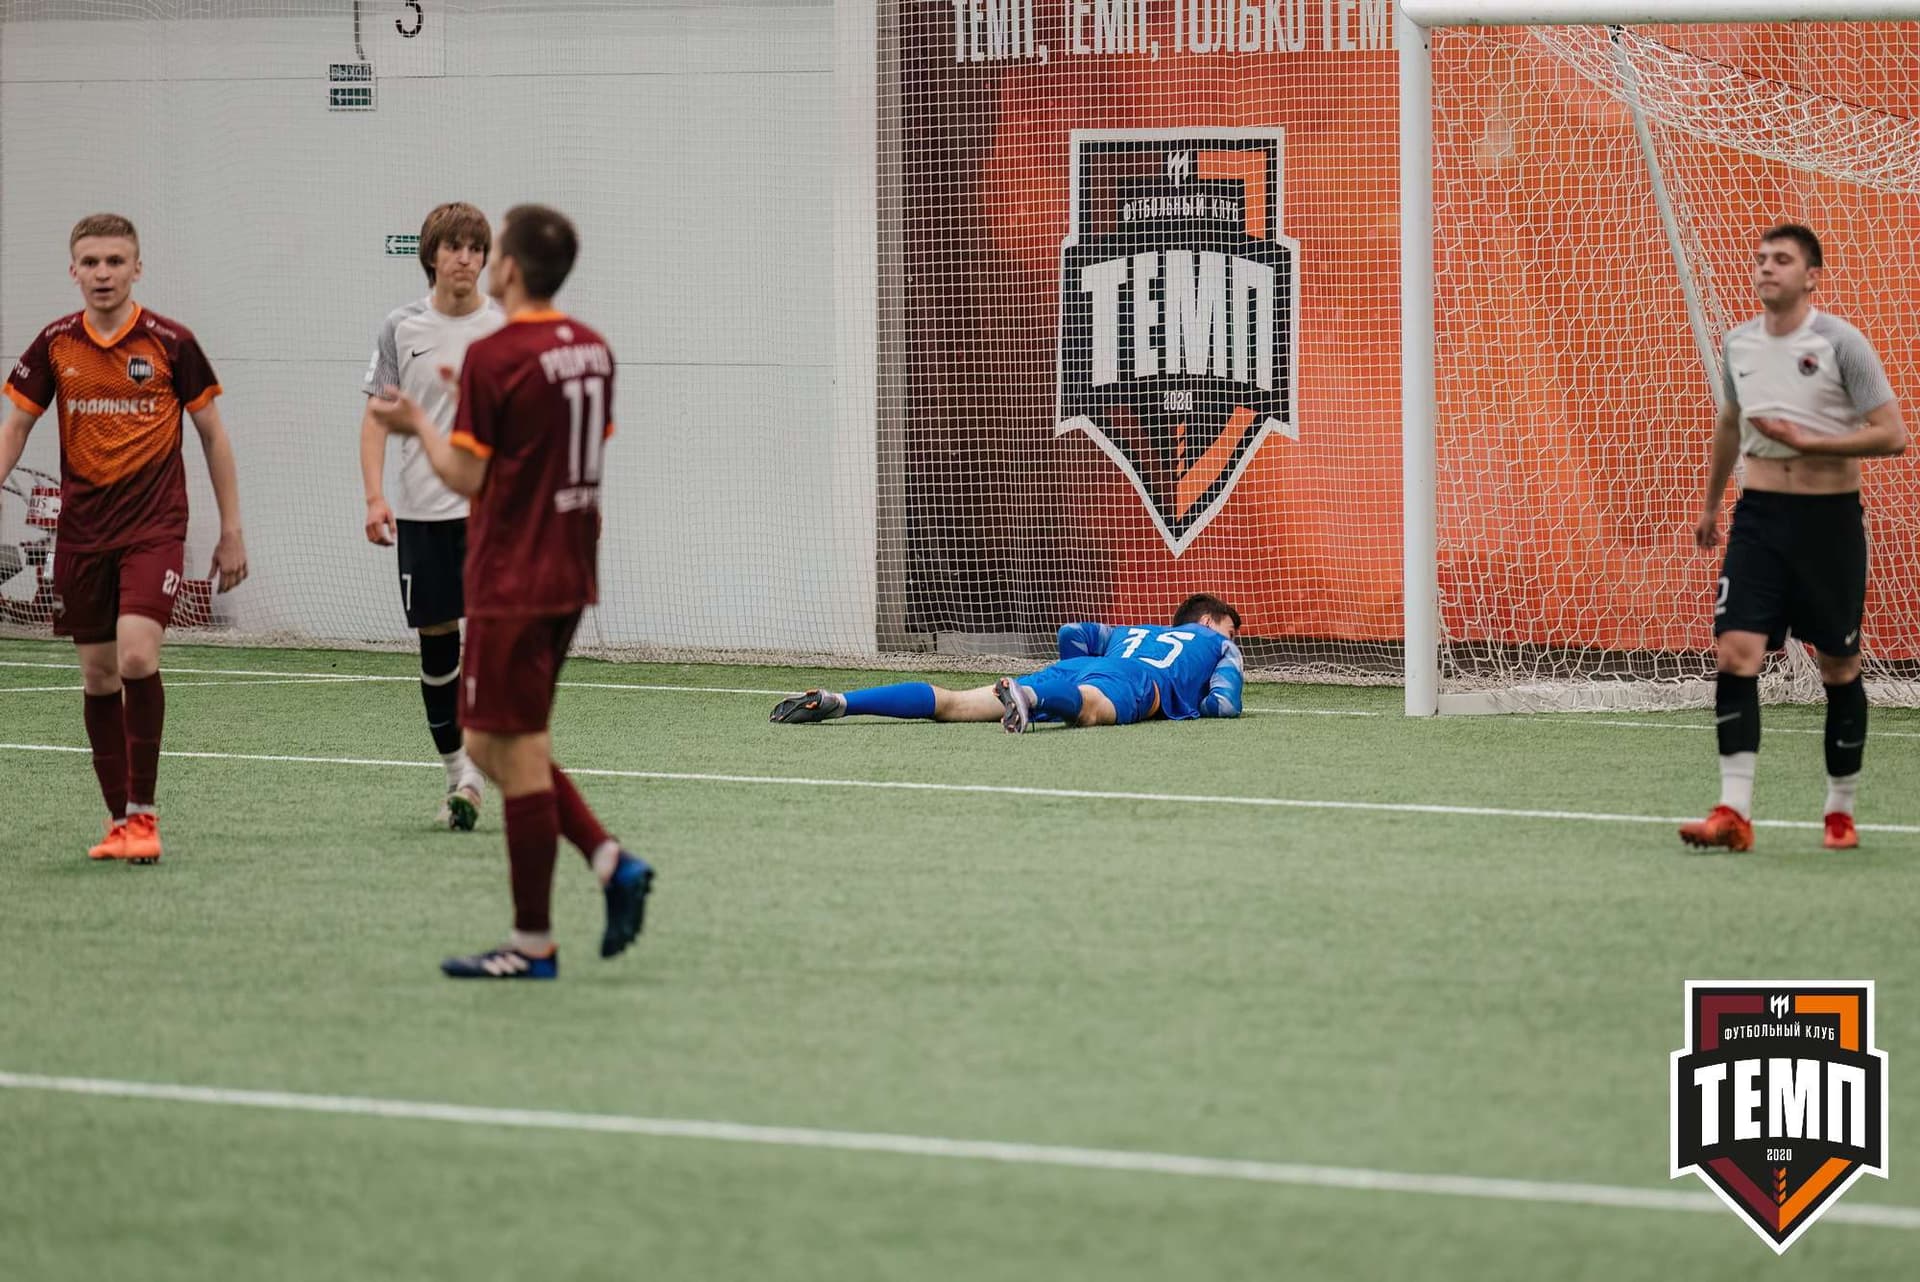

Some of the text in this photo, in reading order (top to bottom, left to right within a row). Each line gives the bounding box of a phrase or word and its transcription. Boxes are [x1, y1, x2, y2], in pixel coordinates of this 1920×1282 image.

[952, 0, 1048, 65] ТЕМП,
[1123, 192, 1240, 221] ФУТБОЛЬНЫЙ КЛУБ
[1081, 250, 1274, 392] ТЕМП
[562, 378, 604, 485] 11
[1163, 391, 1193, 411] 2020
